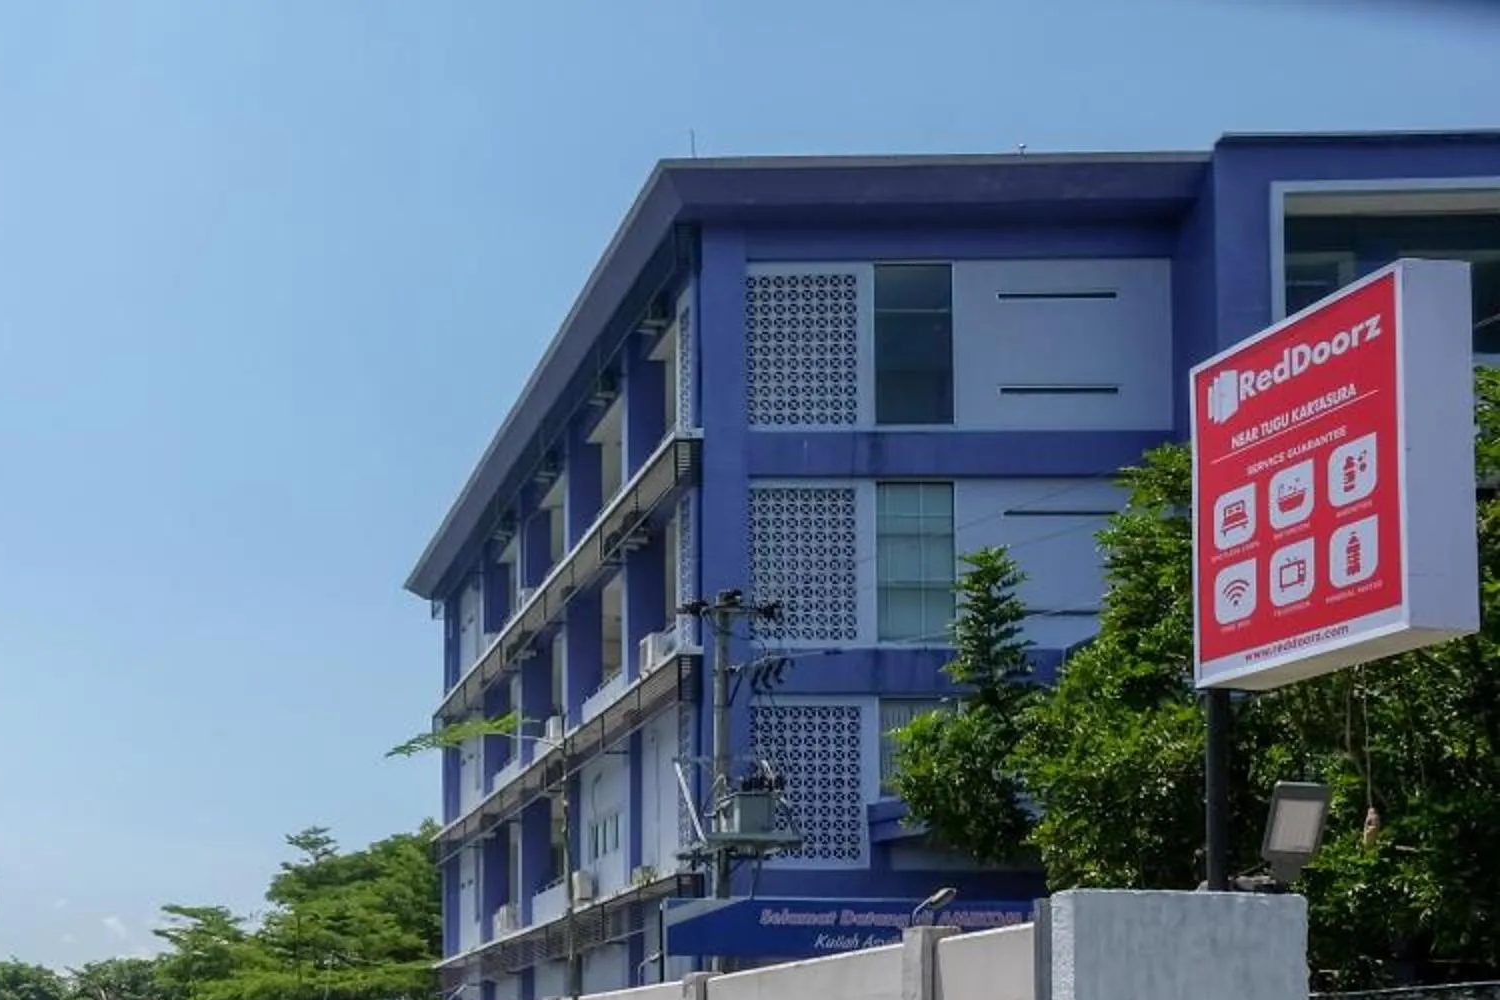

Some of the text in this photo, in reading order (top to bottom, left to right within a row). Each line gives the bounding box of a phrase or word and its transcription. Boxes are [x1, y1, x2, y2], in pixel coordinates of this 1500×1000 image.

[1240, 314, 1382, 400] RedDoorz
[1231, 383, 1357, 450] NEAR TUGU KARTASURA
[760, 908, 837, 925] Selamat
